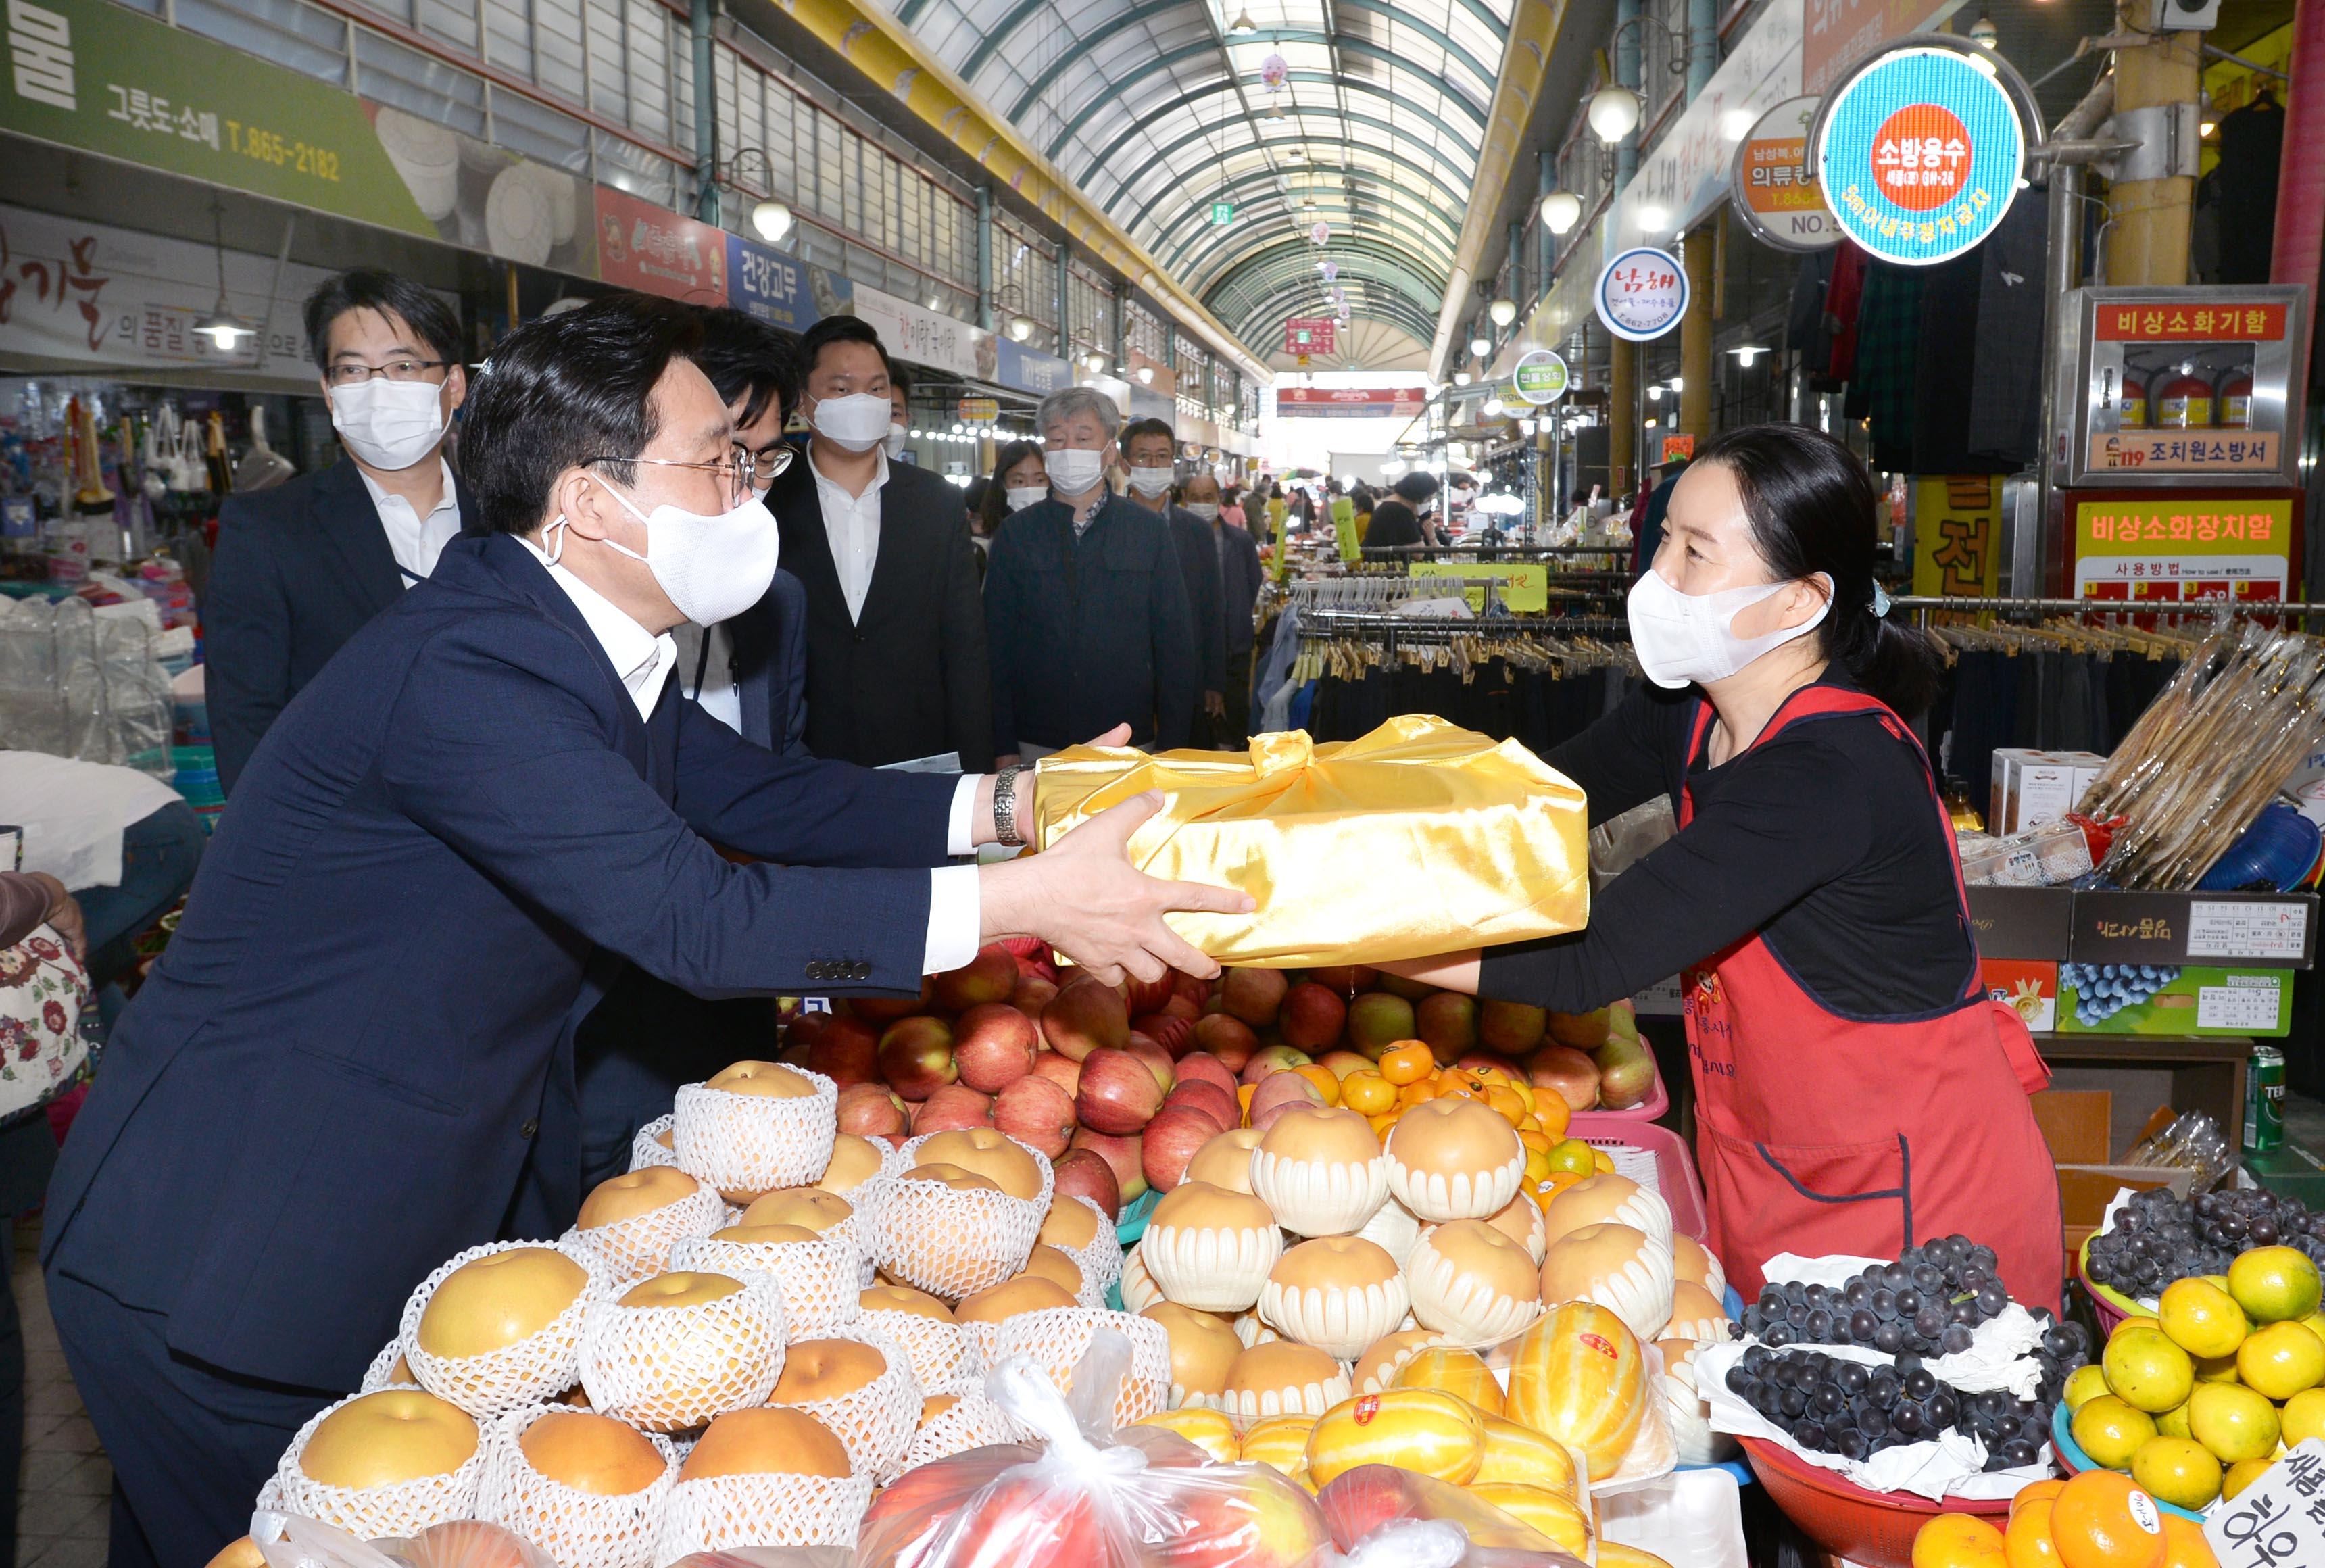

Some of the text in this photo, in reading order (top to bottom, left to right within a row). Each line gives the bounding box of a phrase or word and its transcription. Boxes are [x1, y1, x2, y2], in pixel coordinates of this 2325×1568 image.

[226, 120, 340, 182] T.865-2182
[1878, 137, 1965, 168] 소방용수
[741, 250, 796, 305] 건강고무
[1615, 268, 1675, 293] 남해
[2118, 310, 2268, 335] 비상소화기함
[2120, 441, 2266, 467] 119 조치원소방서
[2091, 513, 2273, 542] 비상소화장치함
[2087, 583, 2092, 593] 1
[2137, 583, 2145, 593] 2
[2187, 583, 2195, 593] 3
[2238, 583, 2246, 593] 4
[2103, 918, 2172, 940] 명품사과
